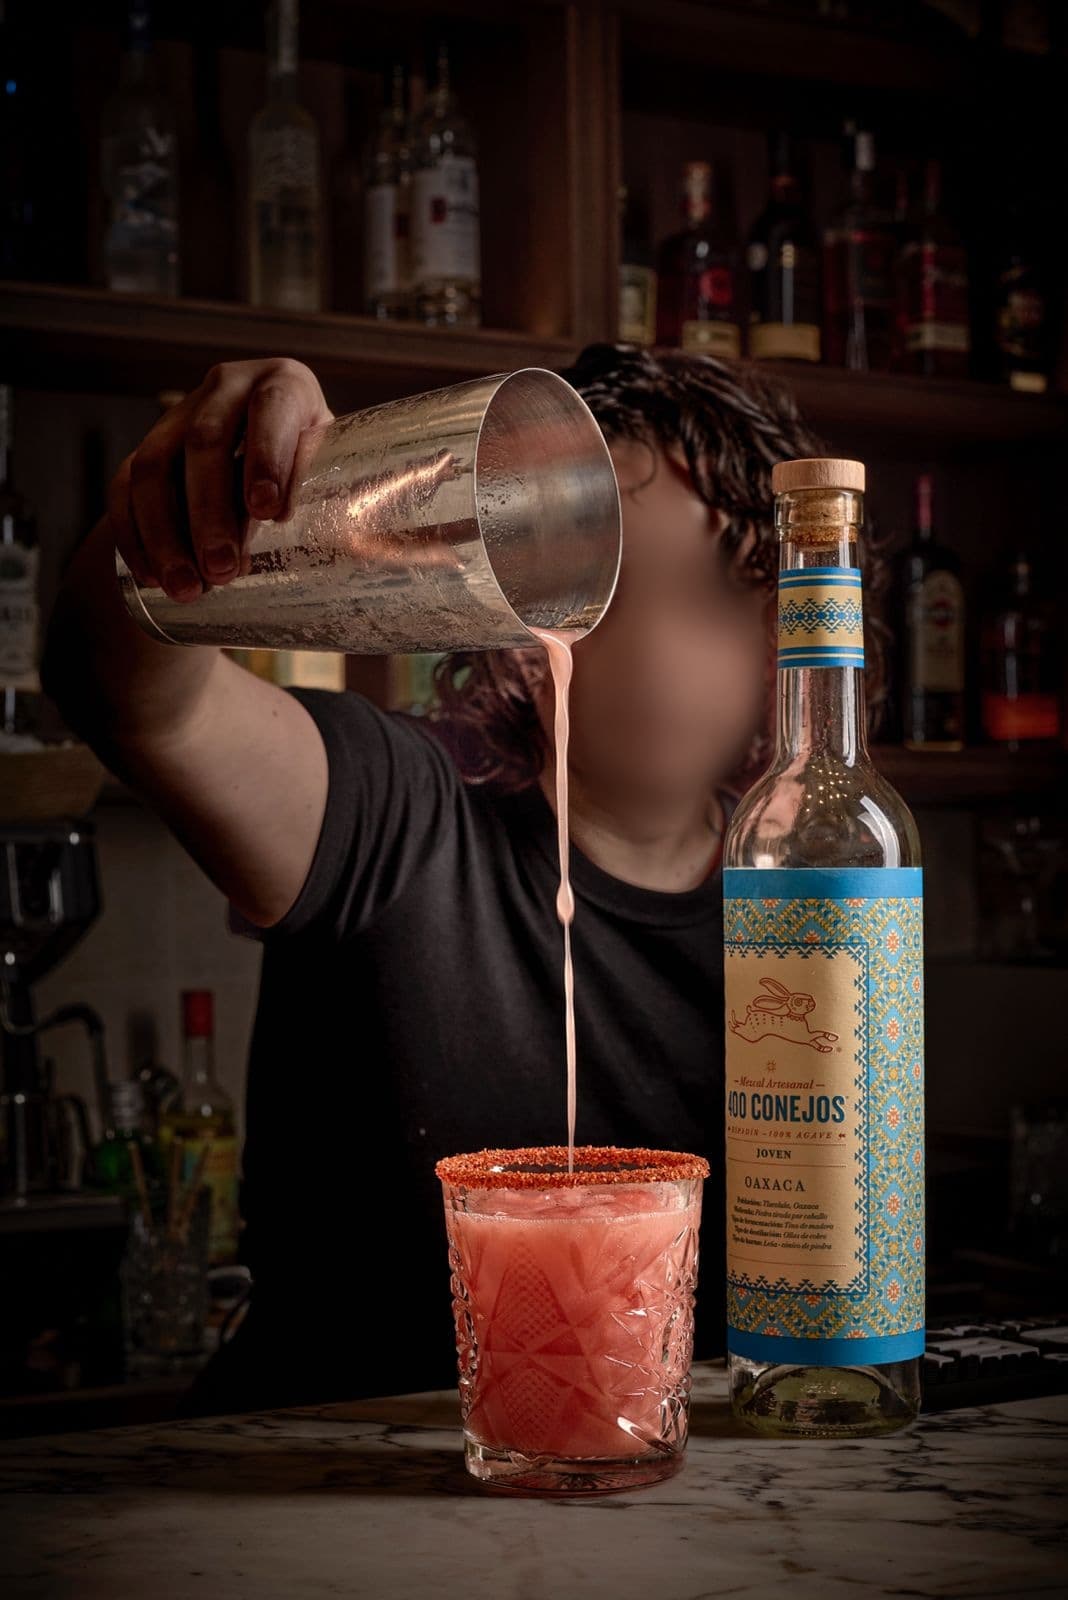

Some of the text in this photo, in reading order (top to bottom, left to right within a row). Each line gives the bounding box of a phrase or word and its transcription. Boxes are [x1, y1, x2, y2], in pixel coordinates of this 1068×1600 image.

[740, 1076, 814, 1089] Mezcal Artesanal
[728, 1090, 845, 1123] 400 CONEJOS
[796, 1131, 832, 1140] AGAVE
[756, 1148, 792, 1159] JOVEN
[745, 1176, 806, 1192] OAXACA
